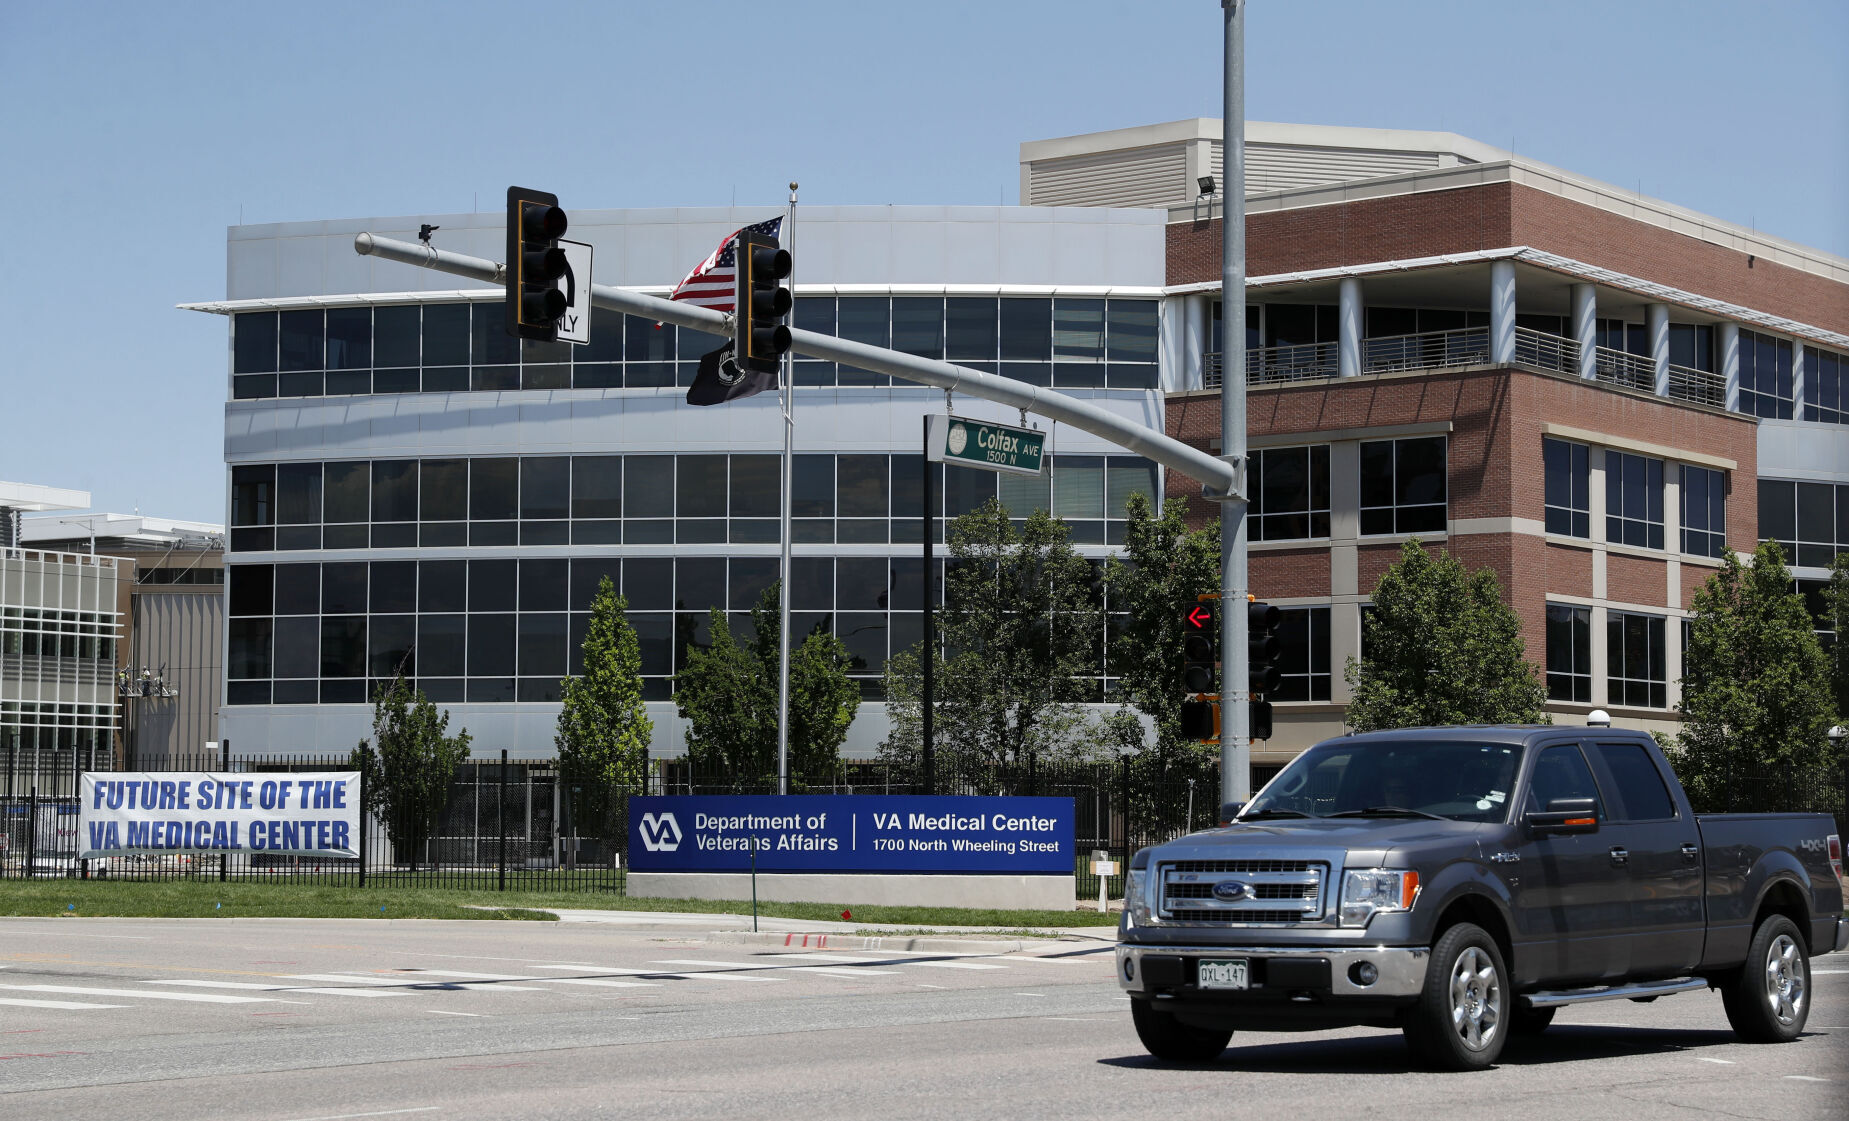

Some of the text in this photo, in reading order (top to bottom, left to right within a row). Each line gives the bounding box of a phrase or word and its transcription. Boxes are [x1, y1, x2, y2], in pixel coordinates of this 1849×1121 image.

[557, 313, 578, 333] NLY
[978, 427, 1019, 453] Colfax
[1022, 444, 1039, 457] AVE
[986, 450, 1017, 465] 1500 N
[93, 780, 346, 810] FUTURE SITE OF THE
[638, 812, 683, 852] VA
[695, 812, 827, 833] Department of
[873, 813, 1057, 832] VA Medical Center
[88, 820, 350, 850] VA MEDICAL CENTER
[696, 833, 839, 851] Veterans Affairs
[873, 839, 1059, 855] 1700 North Wheeling Street
